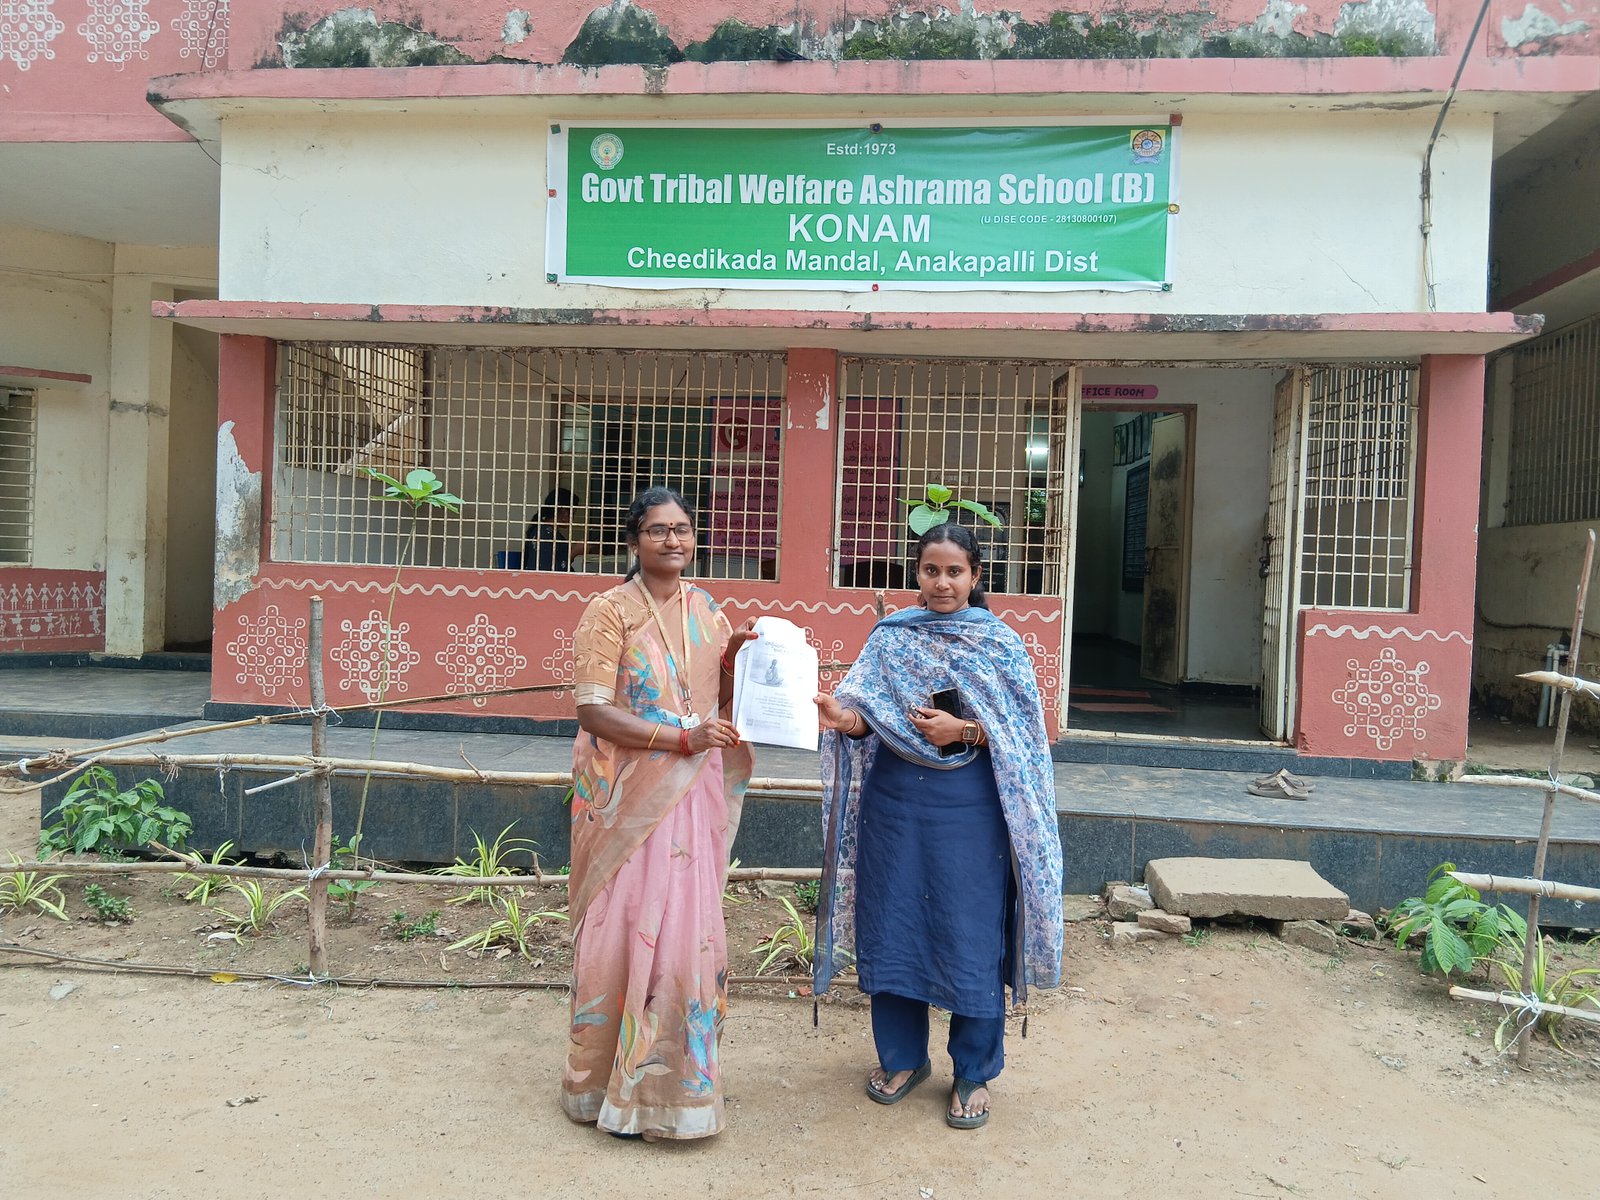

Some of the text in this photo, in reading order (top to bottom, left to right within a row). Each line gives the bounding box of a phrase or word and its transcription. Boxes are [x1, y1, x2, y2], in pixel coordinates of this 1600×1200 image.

[826, 143, 896, 156] Estd:1973
[581, 172, 1155, 205] Govt Tribal Welfare Ashrama School (B)
[788, 213, 931, 243] KONAM
[980, 216, 992, 224] (U
[993, 215, 1017, 224] DISE
[1019, 215, 1047, 224] CODE
[1055, 214, 1118, 224] 28130800107)
[627, 246, 1099, 277] Cheedikada Mandal, Anakapalli Dist
[1114, 387, 1145, 396] ROOM
